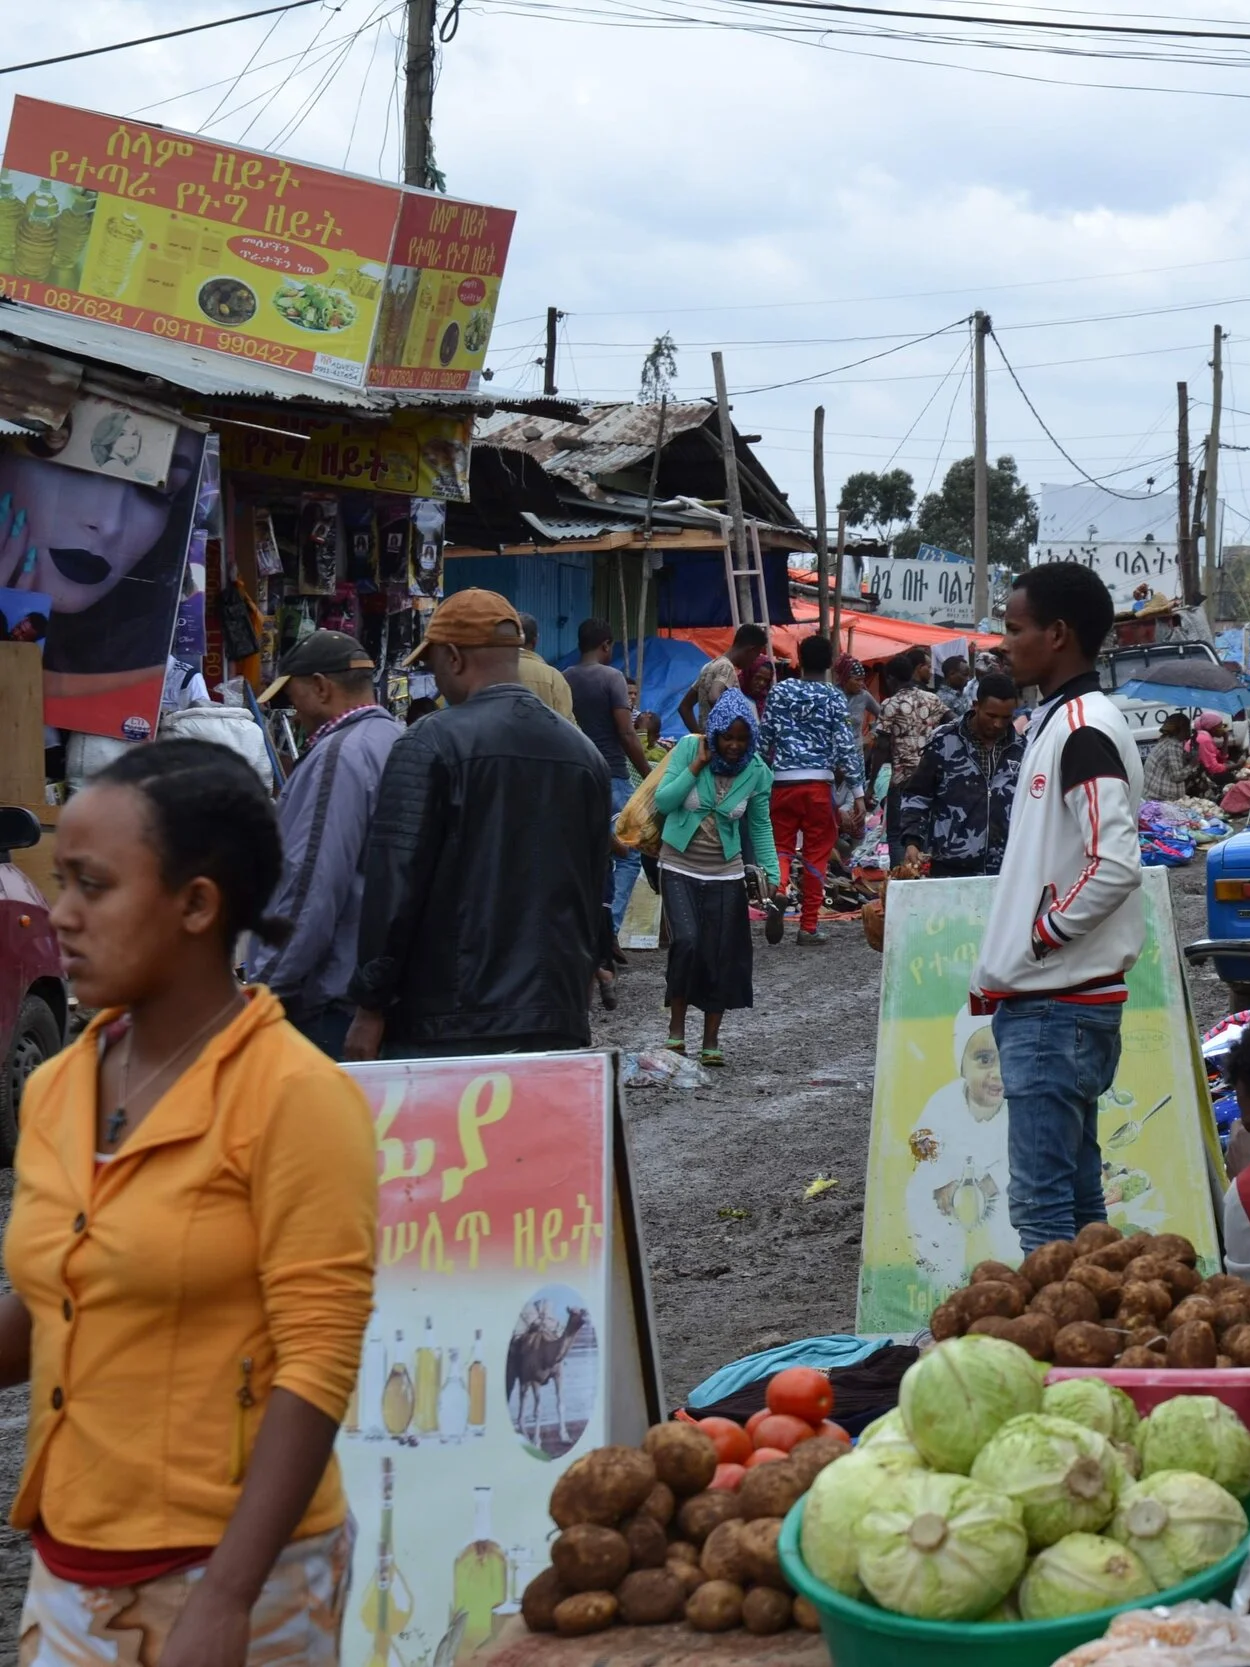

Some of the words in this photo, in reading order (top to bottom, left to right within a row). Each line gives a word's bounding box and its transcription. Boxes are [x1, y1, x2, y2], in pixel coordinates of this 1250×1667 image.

[106, 125, 193, 168] ሰላም
[212, 151, 300, 198] ዘይት
[49, 149, 156, 198] የተጣራ
[176, 181, 249, 223] የኑግ
[264, 204, 344, 246] ዘይት
[428, 200, 458, 234] ሰላም
[460, 207, 488, 240] ዘይት
[408, 236, 442, 267] የተጣራ
[445, 242, 470, 270] የኑግ
[471, 243, 496, 274] ዘይት
[44, 289, 123, 323] 087624
[152, 316, 205, 344] 0911
[217, 332, 298, 367] 990427
[321, 442, 389, 482] ዘይት
[938, 565, 991, 605] ባልት
[1123, 705, 1203, 726] YOA
[513, 1193, 603, 1274] ዘይት
